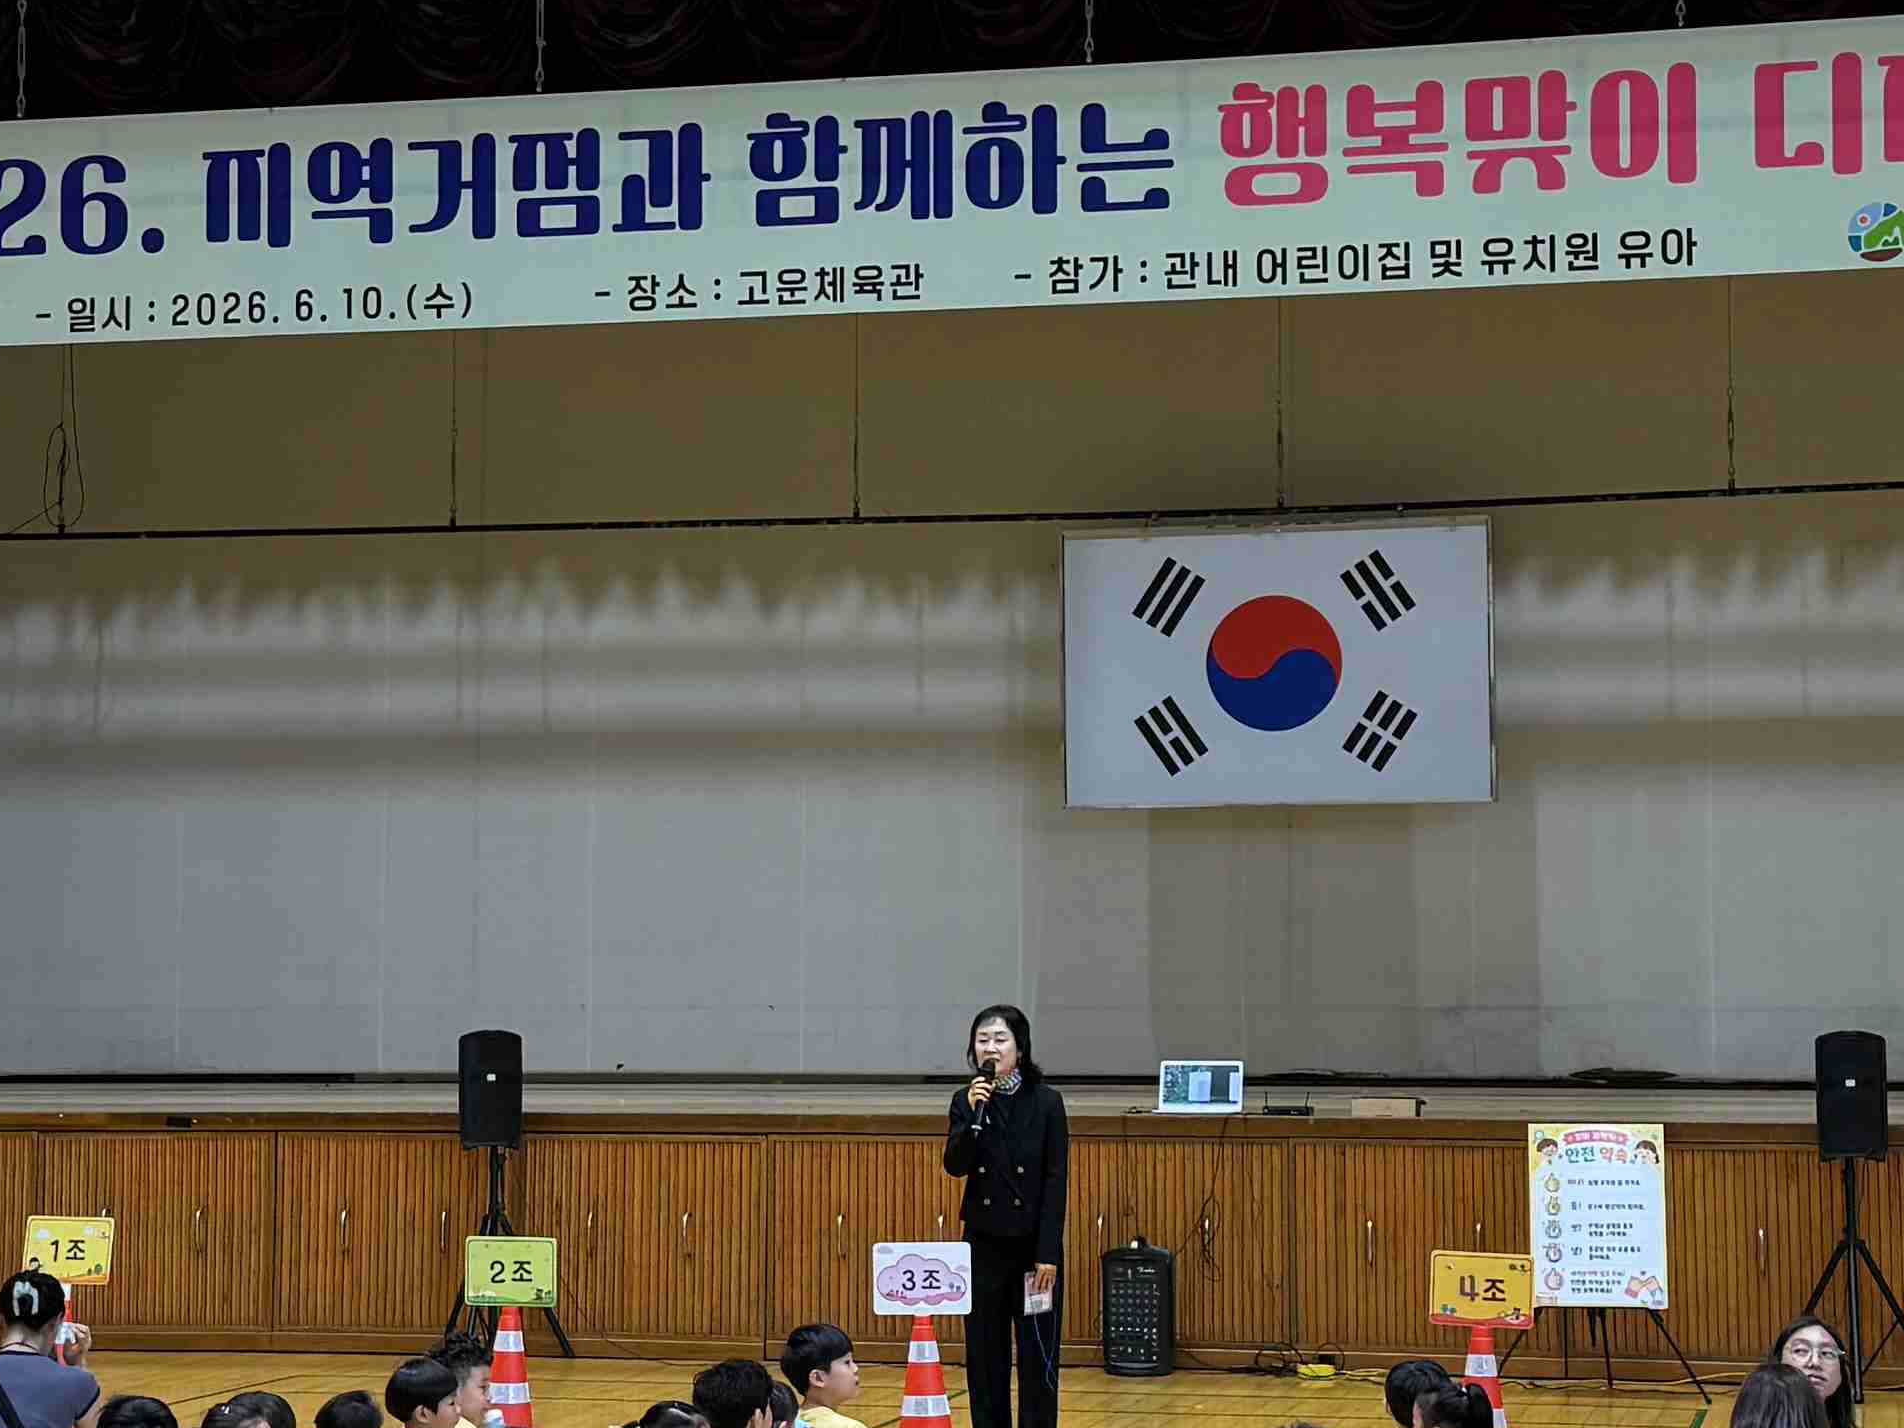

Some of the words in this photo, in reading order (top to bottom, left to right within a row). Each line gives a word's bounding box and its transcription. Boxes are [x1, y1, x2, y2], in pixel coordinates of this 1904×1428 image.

[204, 122, 712, 249] 지역거점과
[746, 101, 1175, 234] 함께하는
[1220, 63, 1698, 206] 행복맞이
[1048, 254, 1124, 295] 참가
[1164, 249, 1238, 290] 관내
[1256, 241, 1411, 286] 어린이집
[1429, 238, 1463, 279] 및
[1480, 232, 1600, 276] 유치원
[1617, 227, 1698, 270] 유아
[627, 273, 698, 312] 장소
[737, 263, 925, 306] 고운체육관
[67, 295, 131, 333] 일시
[1565, 1146, 1596, 1164] 안전
[48, 1237, 86, 1264] 1조
[489, 1259, 533, 1287] 2조
[901, 1266, 942, 1294] 3조
[1459, 1275, 1508, 1304] 4조
